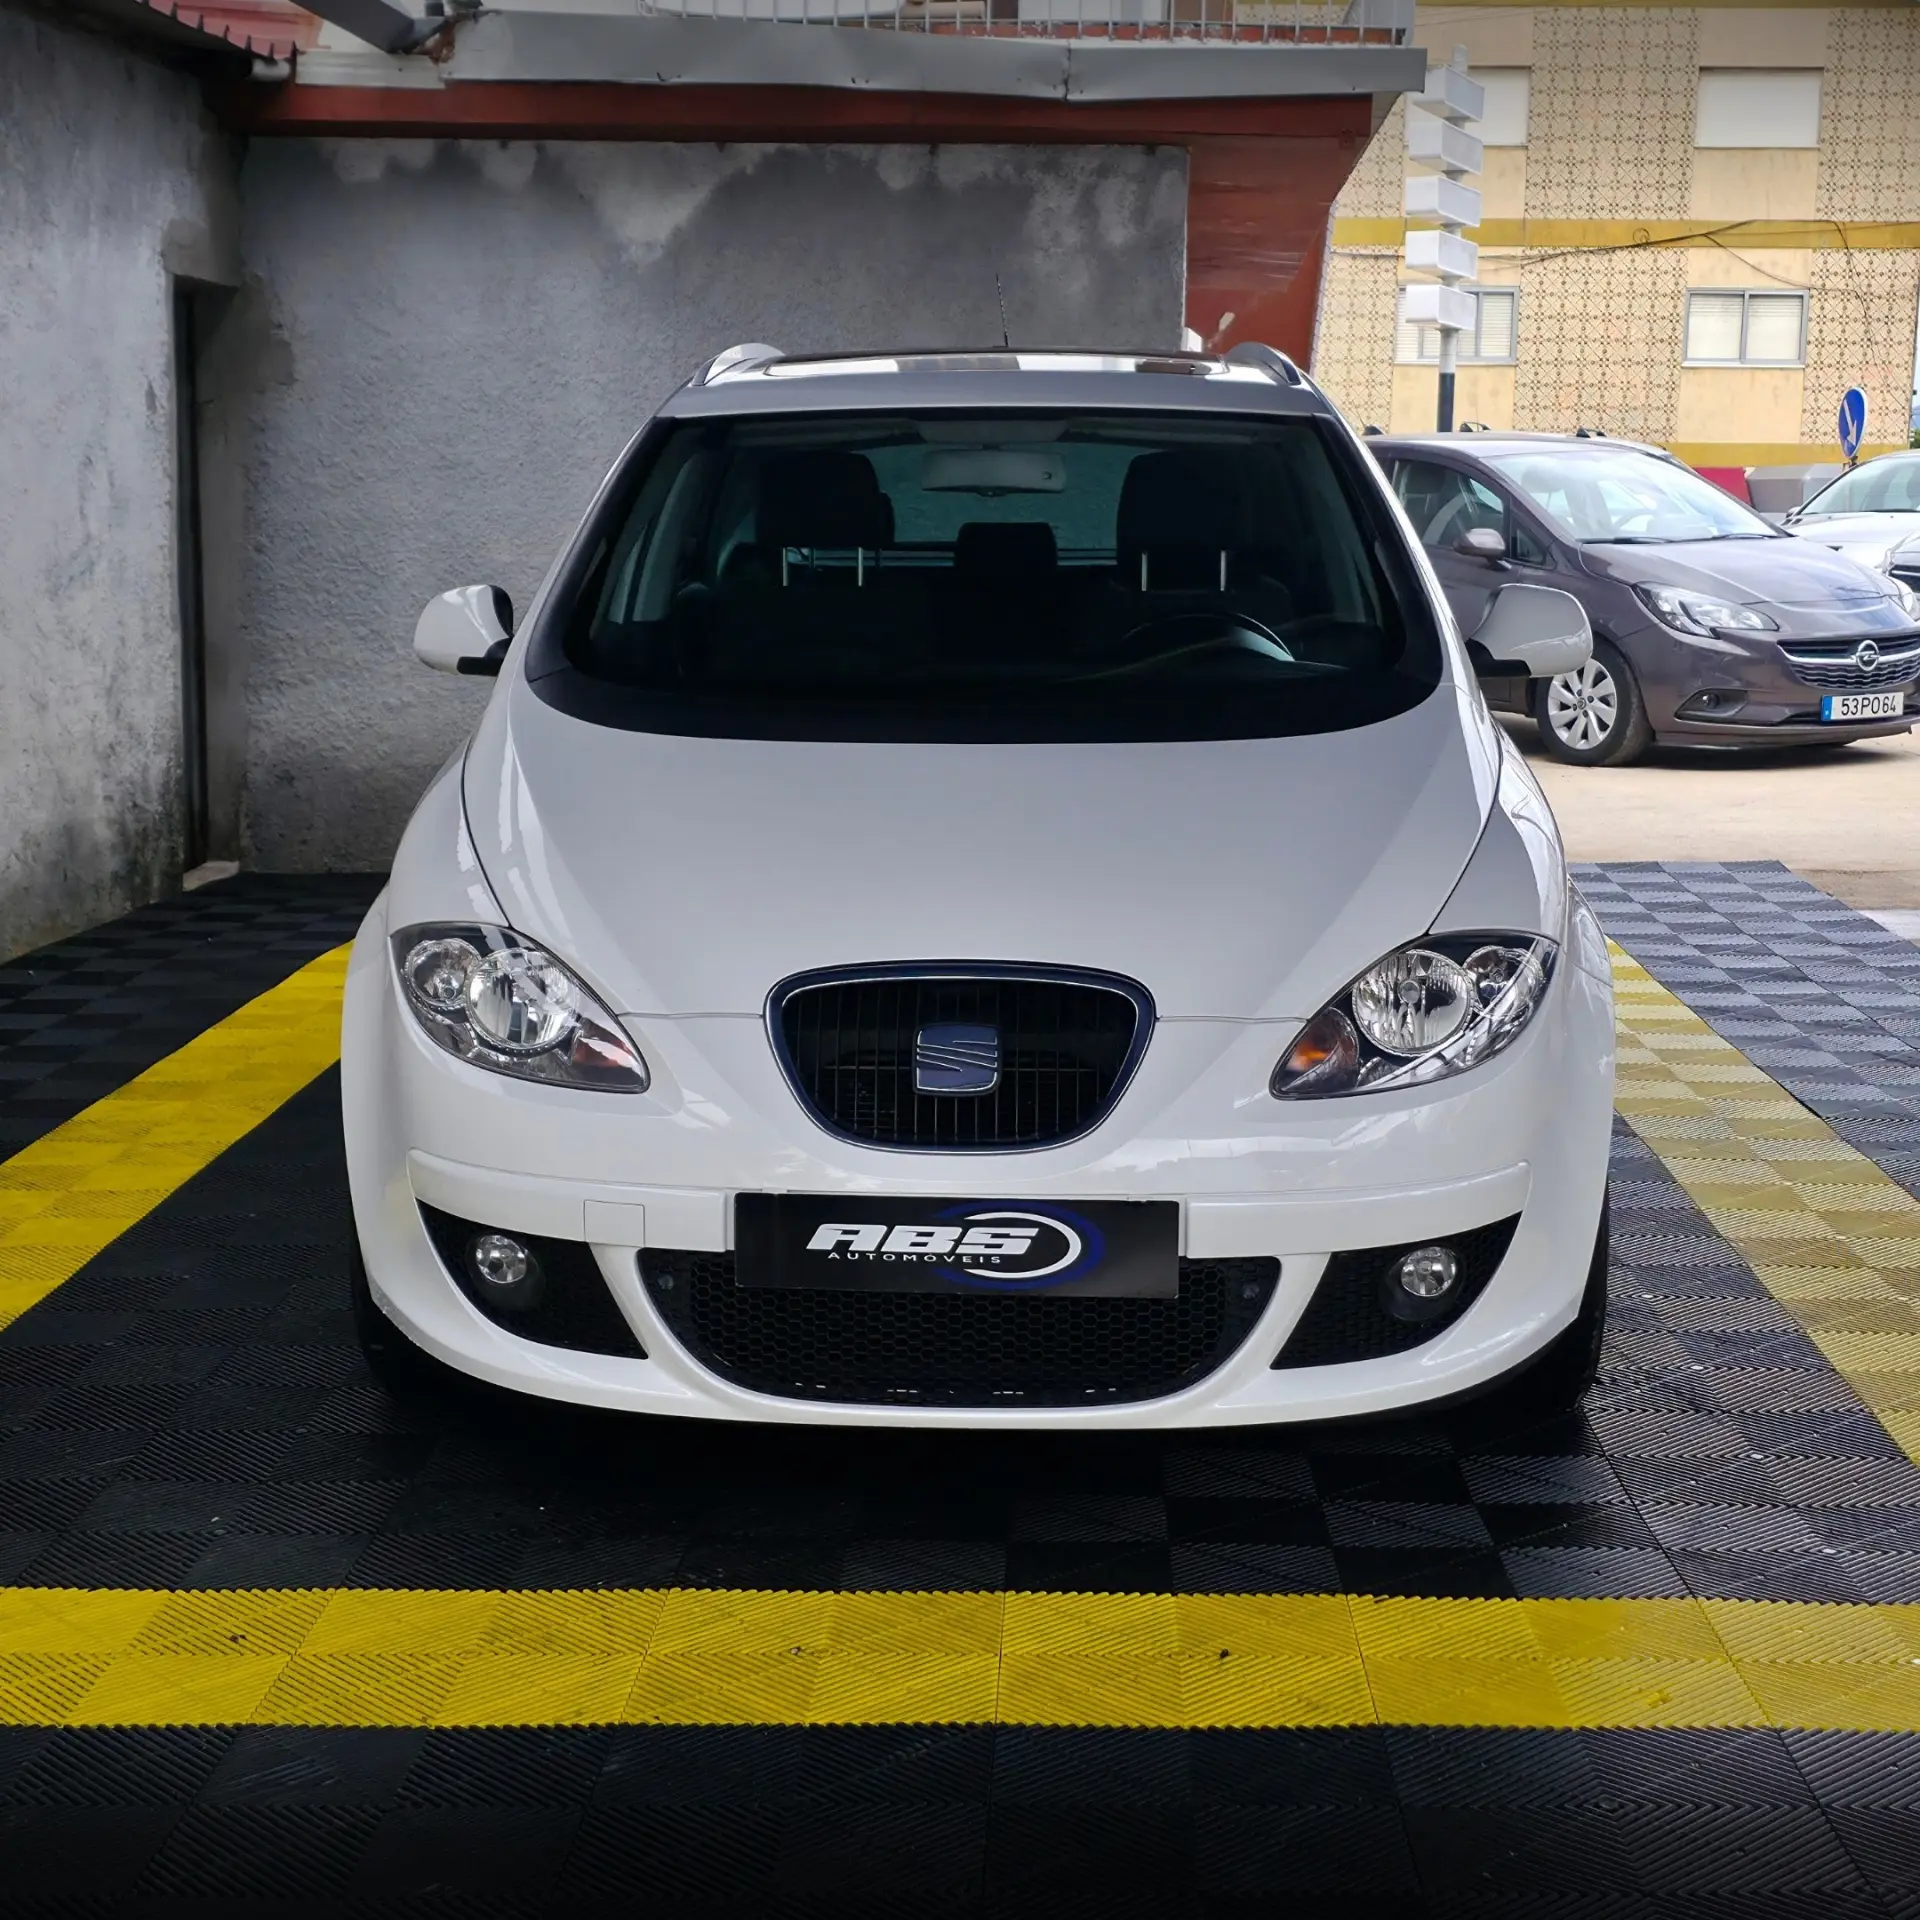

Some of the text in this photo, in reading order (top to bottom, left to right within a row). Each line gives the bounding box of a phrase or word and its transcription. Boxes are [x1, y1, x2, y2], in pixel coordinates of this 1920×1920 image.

[1841, 696, 1896, 716] 53PO64
[806, 1223, 1040, 1255] ABS
[827, 1251, 1001, 1264] AUTOMÓVEIS
